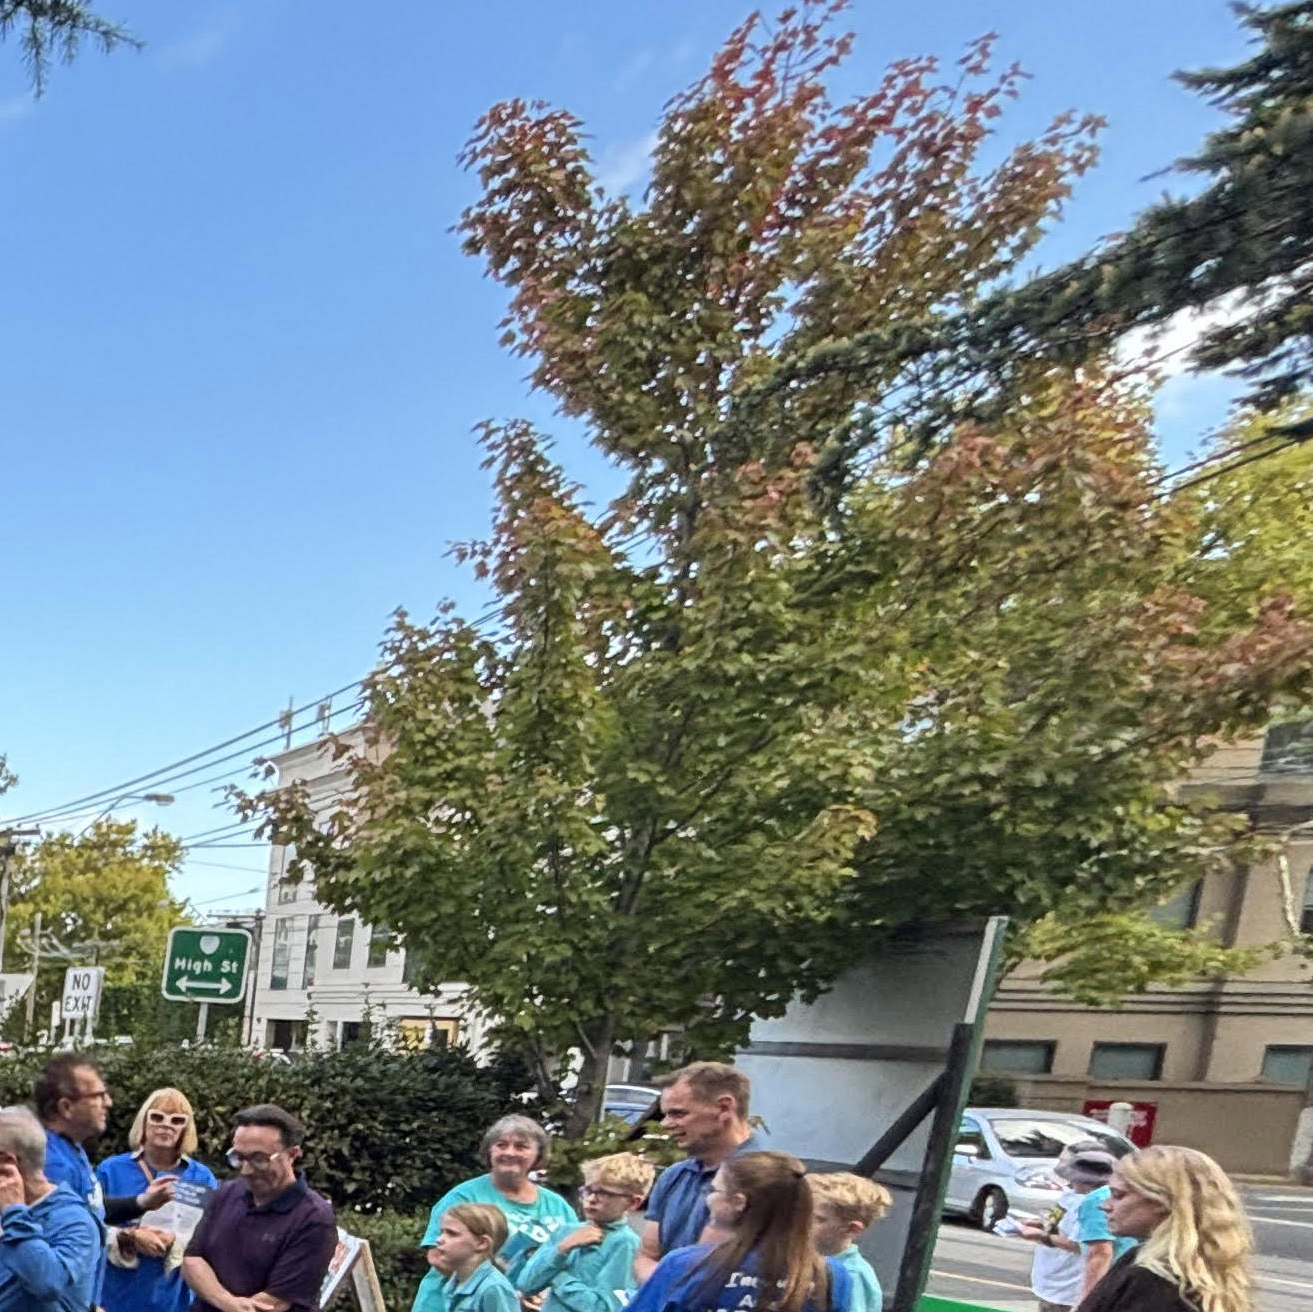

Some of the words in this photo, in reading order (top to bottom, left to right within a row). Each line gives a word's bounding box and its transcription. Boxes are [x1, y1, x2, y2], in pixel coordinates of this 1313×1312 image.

[175, 957, 213, 975] High
[220, 962, 239, 974] St
[71, 973, 91, 991] NO
[65, 995, 93, 1012] EXIT
